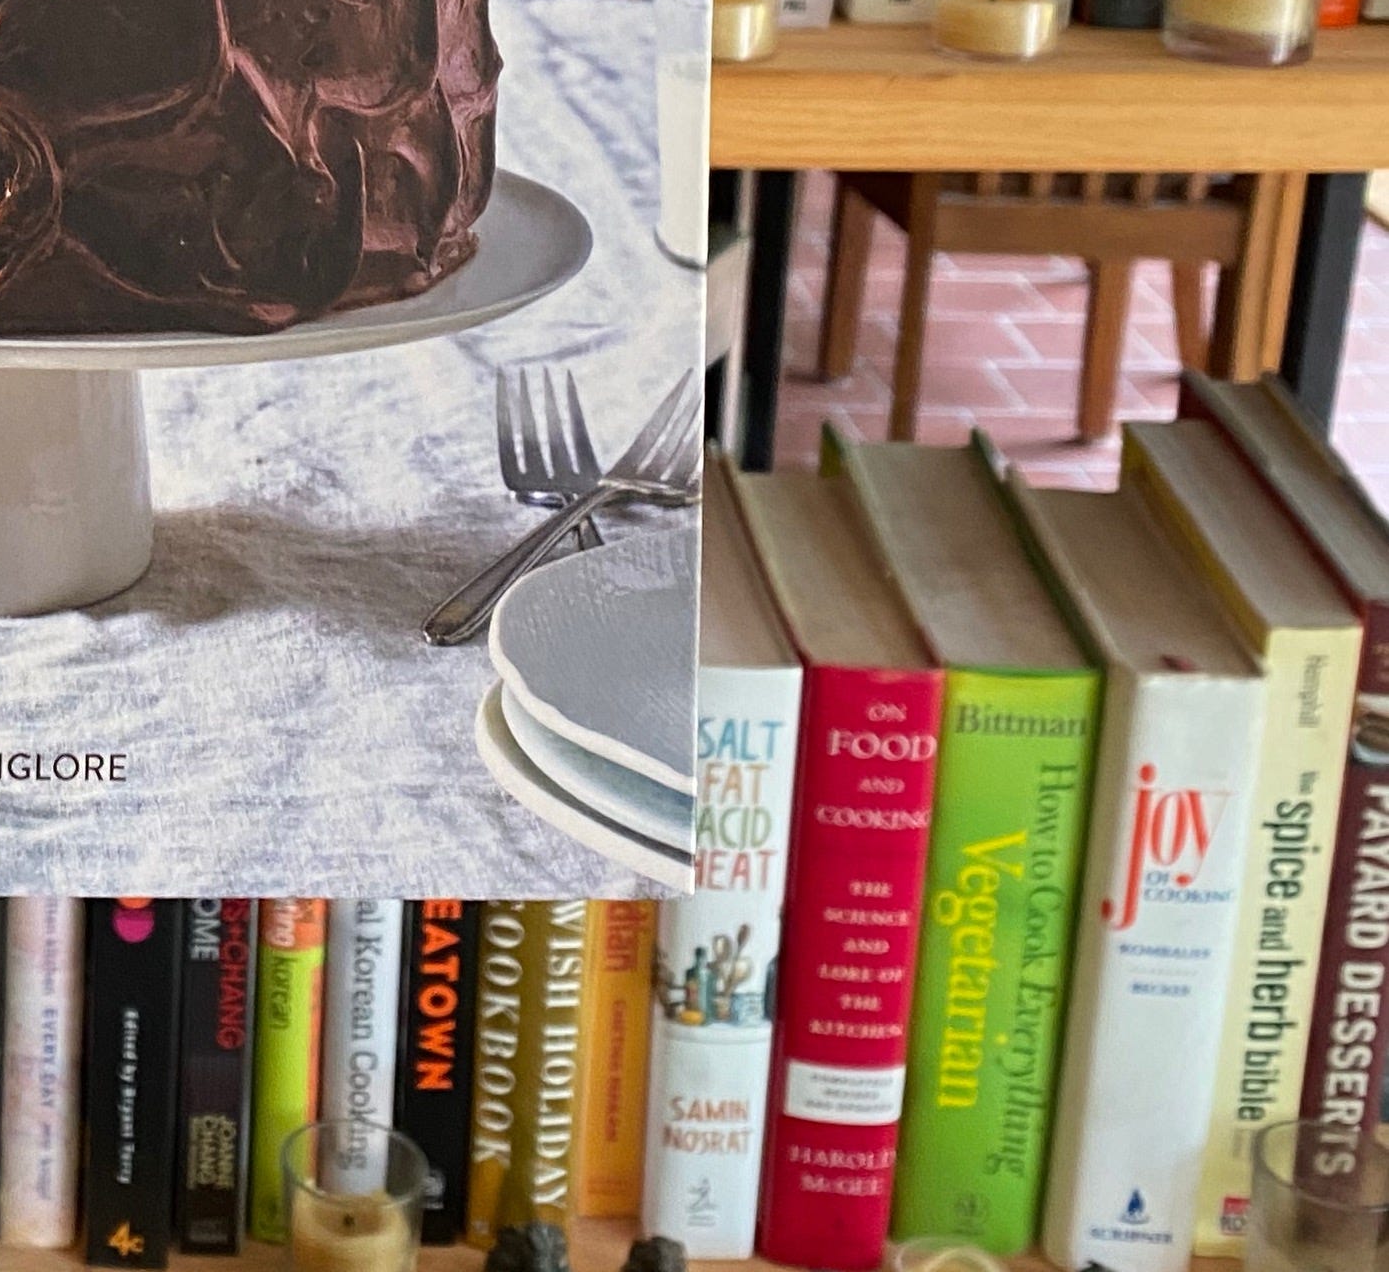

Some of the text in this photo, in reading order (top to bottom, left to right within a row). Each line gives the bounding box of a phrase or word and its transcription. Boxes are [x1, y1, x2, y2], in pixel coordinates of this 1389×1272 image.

[697, 716, 784, 761] SALT
[827, 728, 938, 761] FOOD
[955, 703, 1088, 738] Bittman
[702, 762, 771, 804] FAT
[1039, 760, 1078, 838] How
[696, 806, 773, 851] ACID
[1032, 850, 1053, 880] to
[1100, 763, 1233, 931] joy
[1263, 801, 1323, 900] spice
[1020, 888, 1066, 970] Cook
[1261, 905, 1292, 950] and
[352, 935, 381, 1043] Korean
[932, 830, 1028, 1110] Vegetarian
[1246, 959, 1306, 1045] herb
[1237, 1050, 1277, 1122] bible
[1313, 962, 1384, 1177] DESSERTS
[339, 1050, 379, 1171] Cooking
[531, 1026, 579, 1209] HOLIDAY
[663, 1124, 752, 1156] NOSRAT
